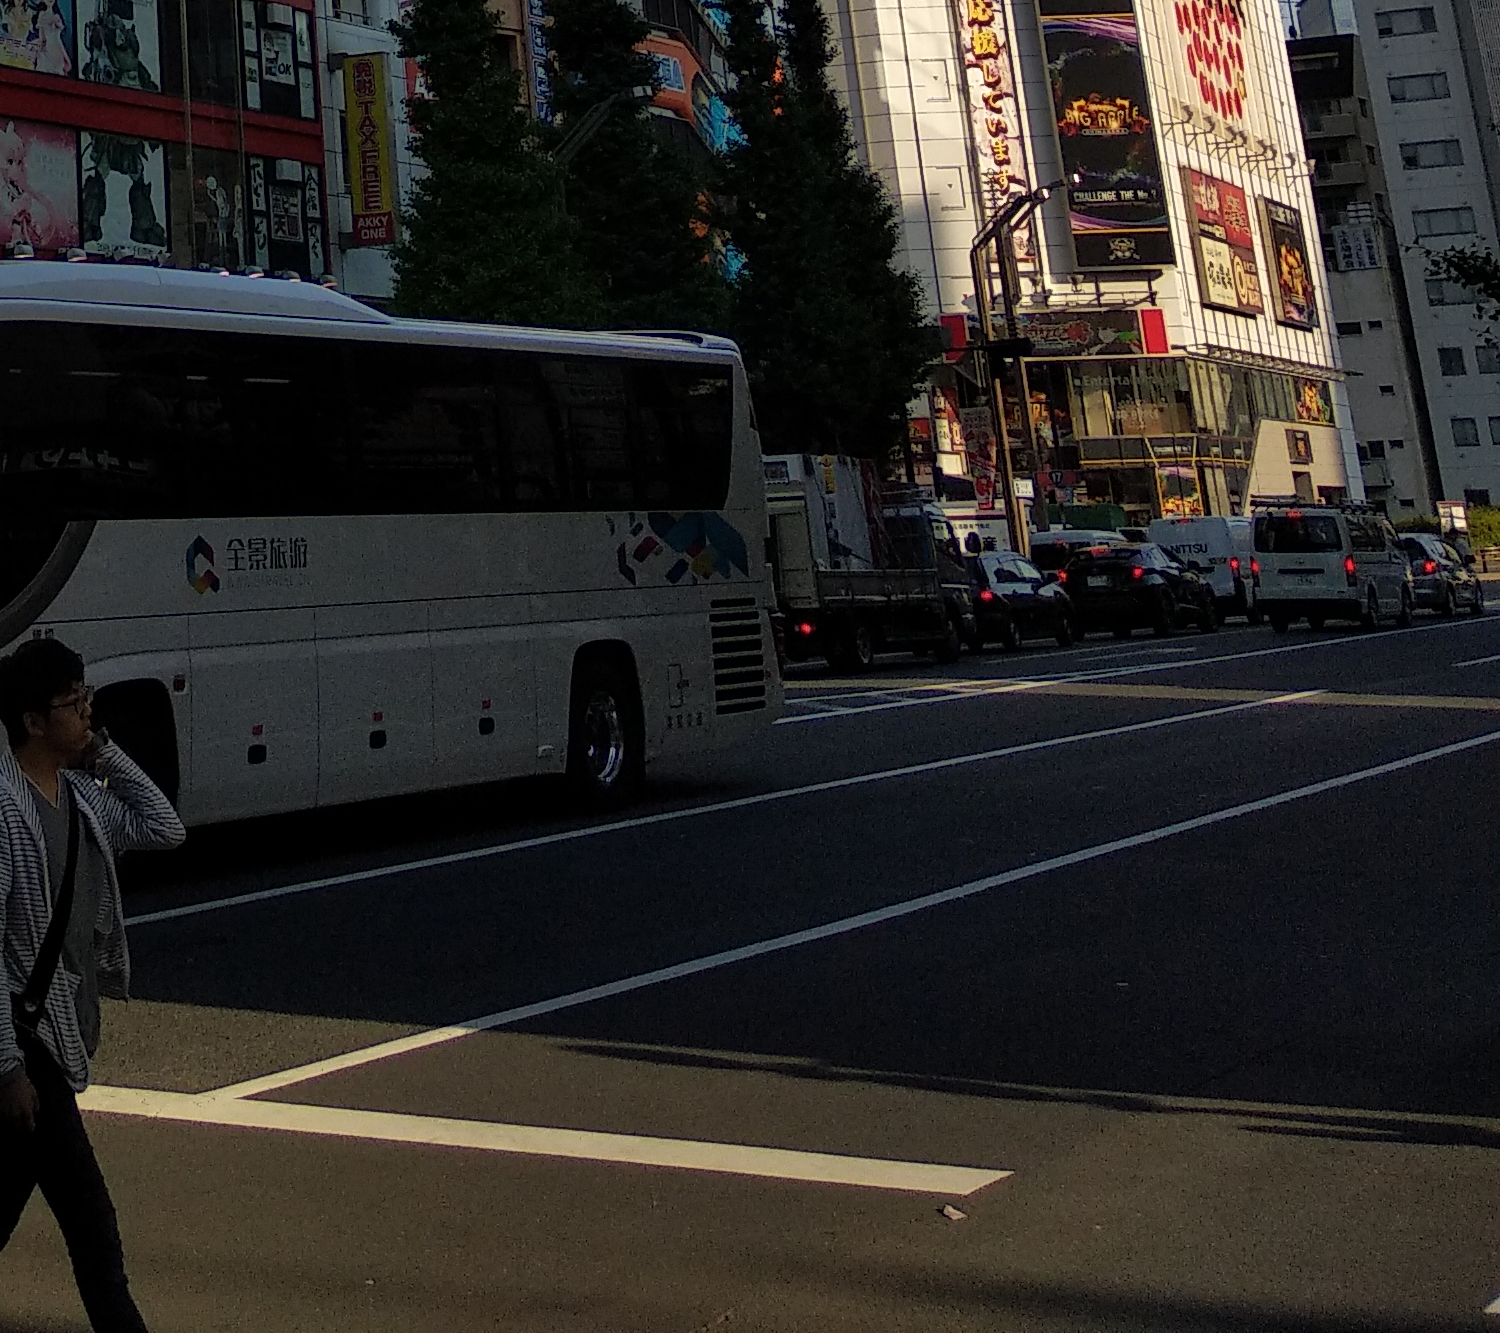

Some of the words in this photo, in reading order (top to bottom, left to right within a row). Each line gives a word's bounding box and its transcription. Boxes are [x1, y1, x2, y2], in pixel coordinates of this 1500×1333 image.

[278, 62, 292, 75] OK
[356, 98, 380, 147] TAX
[362, 148, 383, 211] FREE
[1073, 190, 1117, 202] CHALLENGE
[1120, 189, 1135, 201] THE
[357, 215, 389, 228] AKKY
[361, 226, 387, 239] ONE
[226, 537, 308, 571] 全景旅游
[1170, 542, 1208, 556] NITTSU
